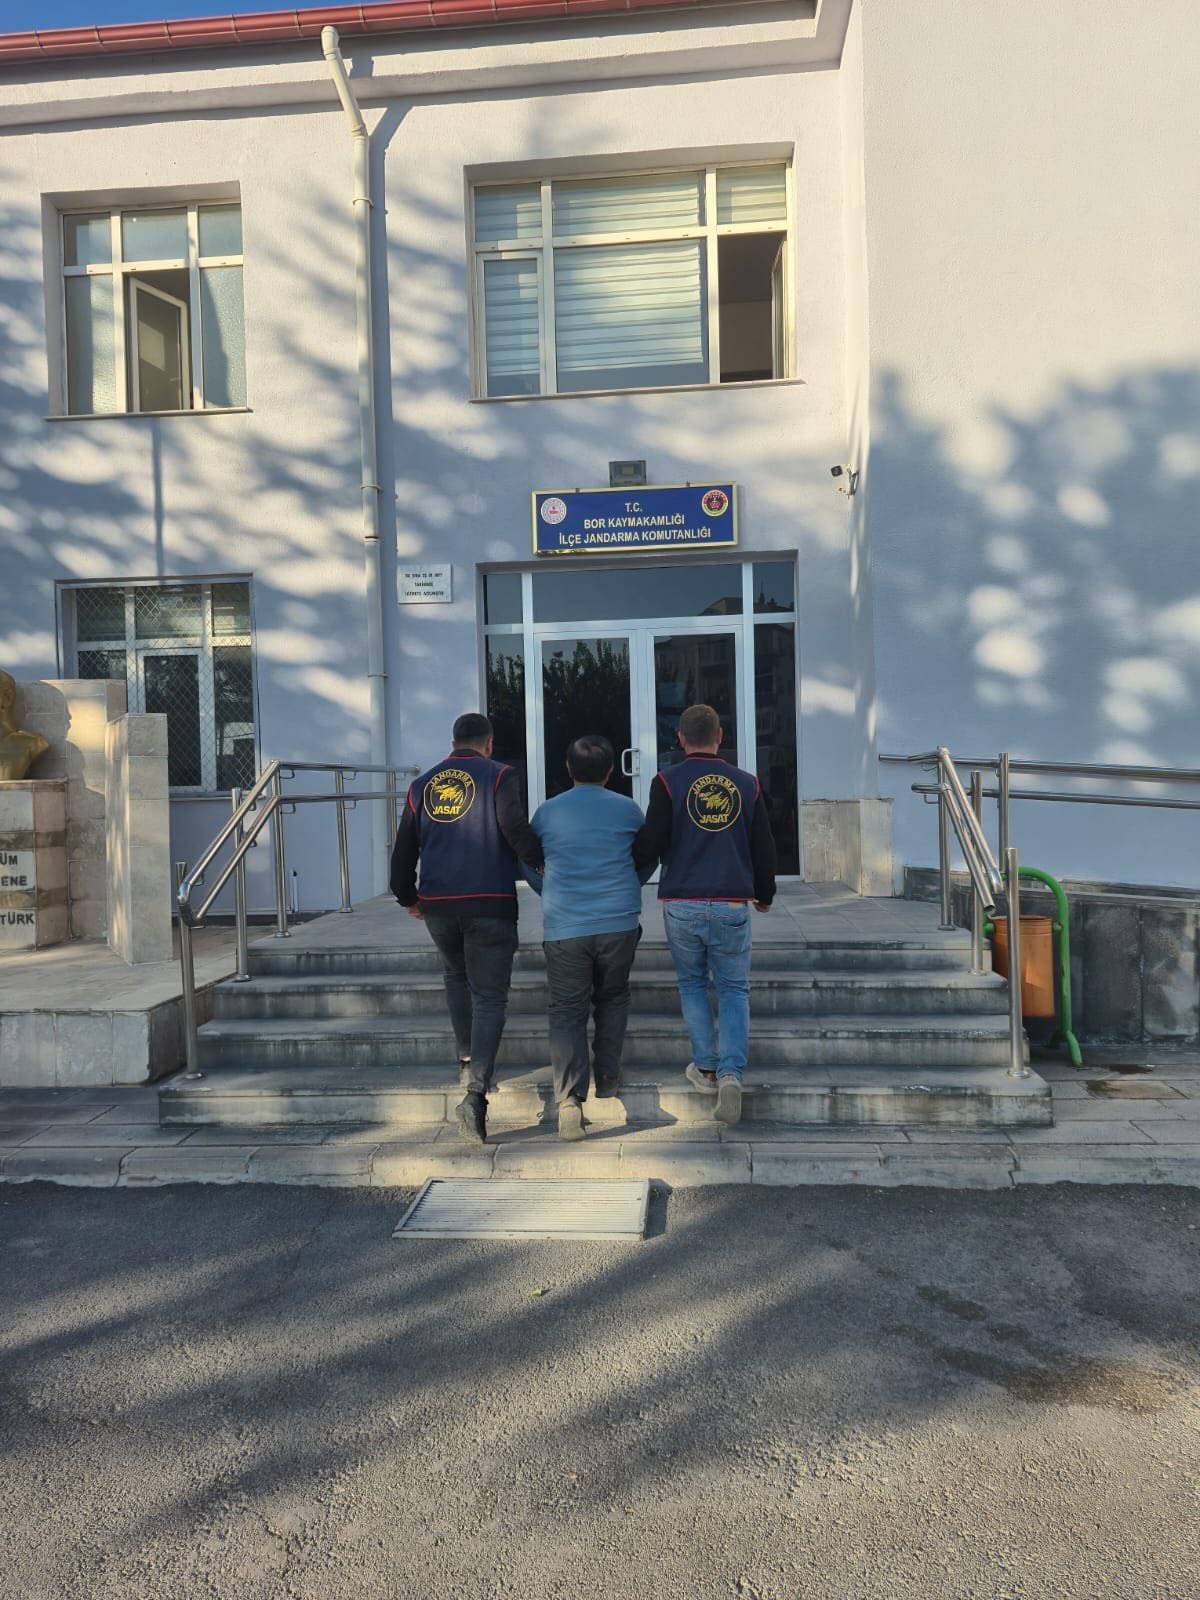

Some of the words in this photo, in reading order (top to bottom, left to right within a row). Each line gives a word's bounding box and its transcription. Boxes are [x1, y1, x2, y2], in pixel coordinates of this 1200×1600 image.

[624, 502, 643, 513] T.C.
[583, 518, 606, 529] BOR
[608, 513, 685, 528] KAYMAKAMLIĞI
[559, 532, 582, 547] İLÇE
[583, 530, 640, 544] JANDARMA
[641, 526, 711, 541] KOMUTANLIĞI
[432, 804, 462, 815] JASAT
[699, 813, 729, 824] JASAT
